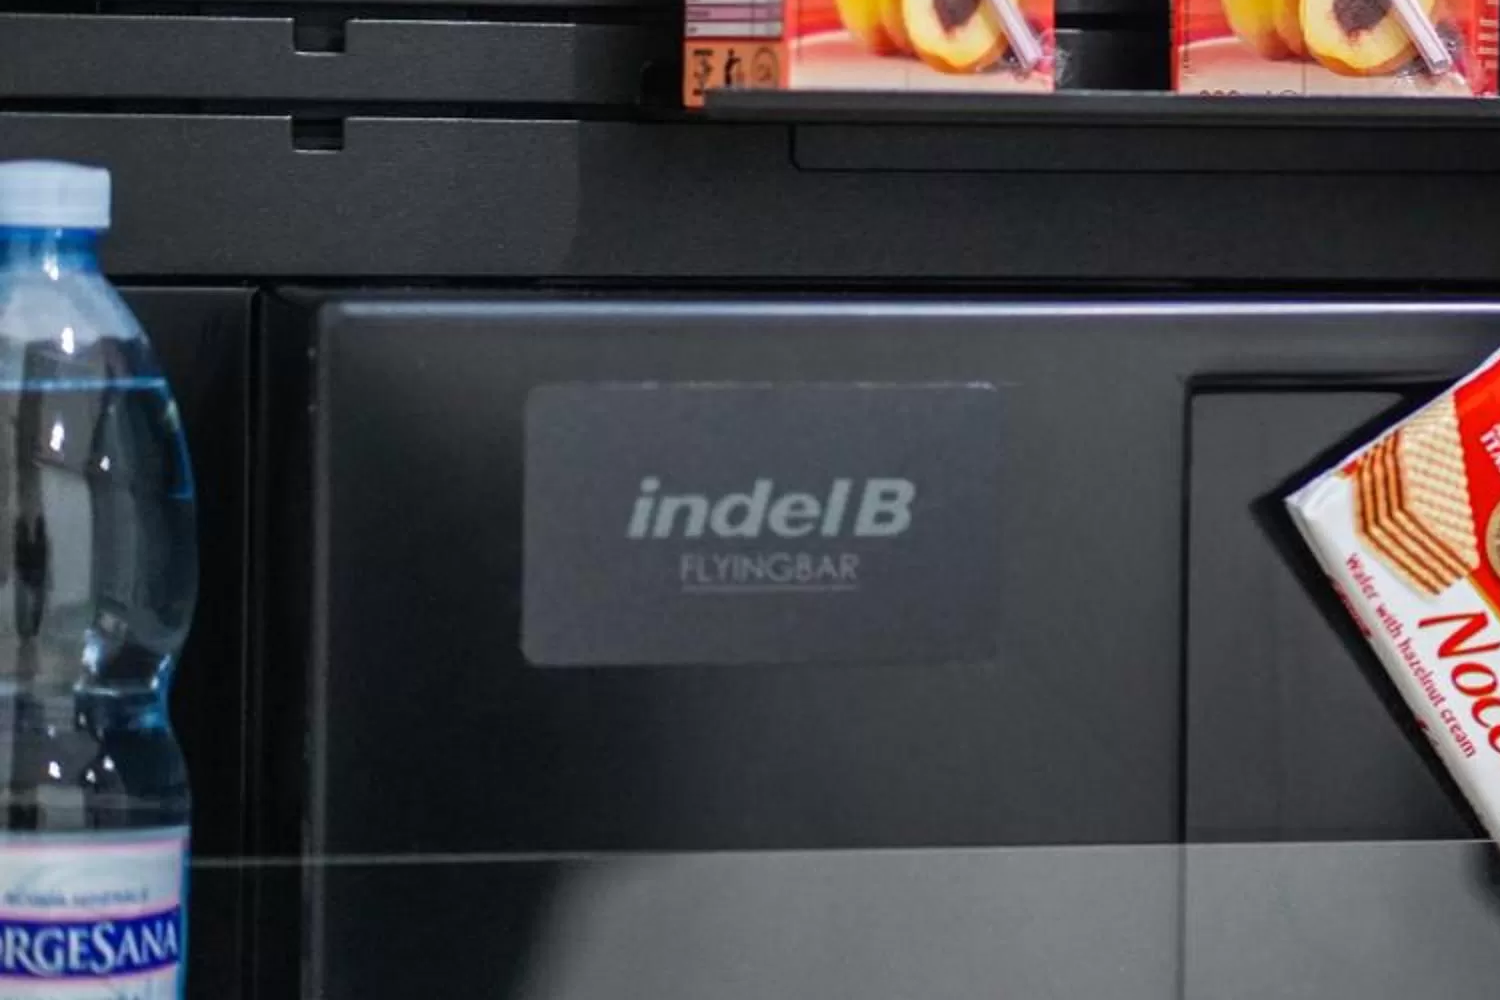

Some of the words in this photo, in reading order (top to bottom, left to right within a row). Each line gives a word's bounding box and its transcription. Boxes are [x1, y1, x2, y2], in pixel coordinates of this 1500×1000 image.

[679, 552, 860, 584] FLYINGBAR
[1346, 552, 1380, 600] Wafer
[1376, 603, 1403, 639] with
[1398, 637, 1446, 708] hazelnut
[1440, 707, 1477, 758] cream
